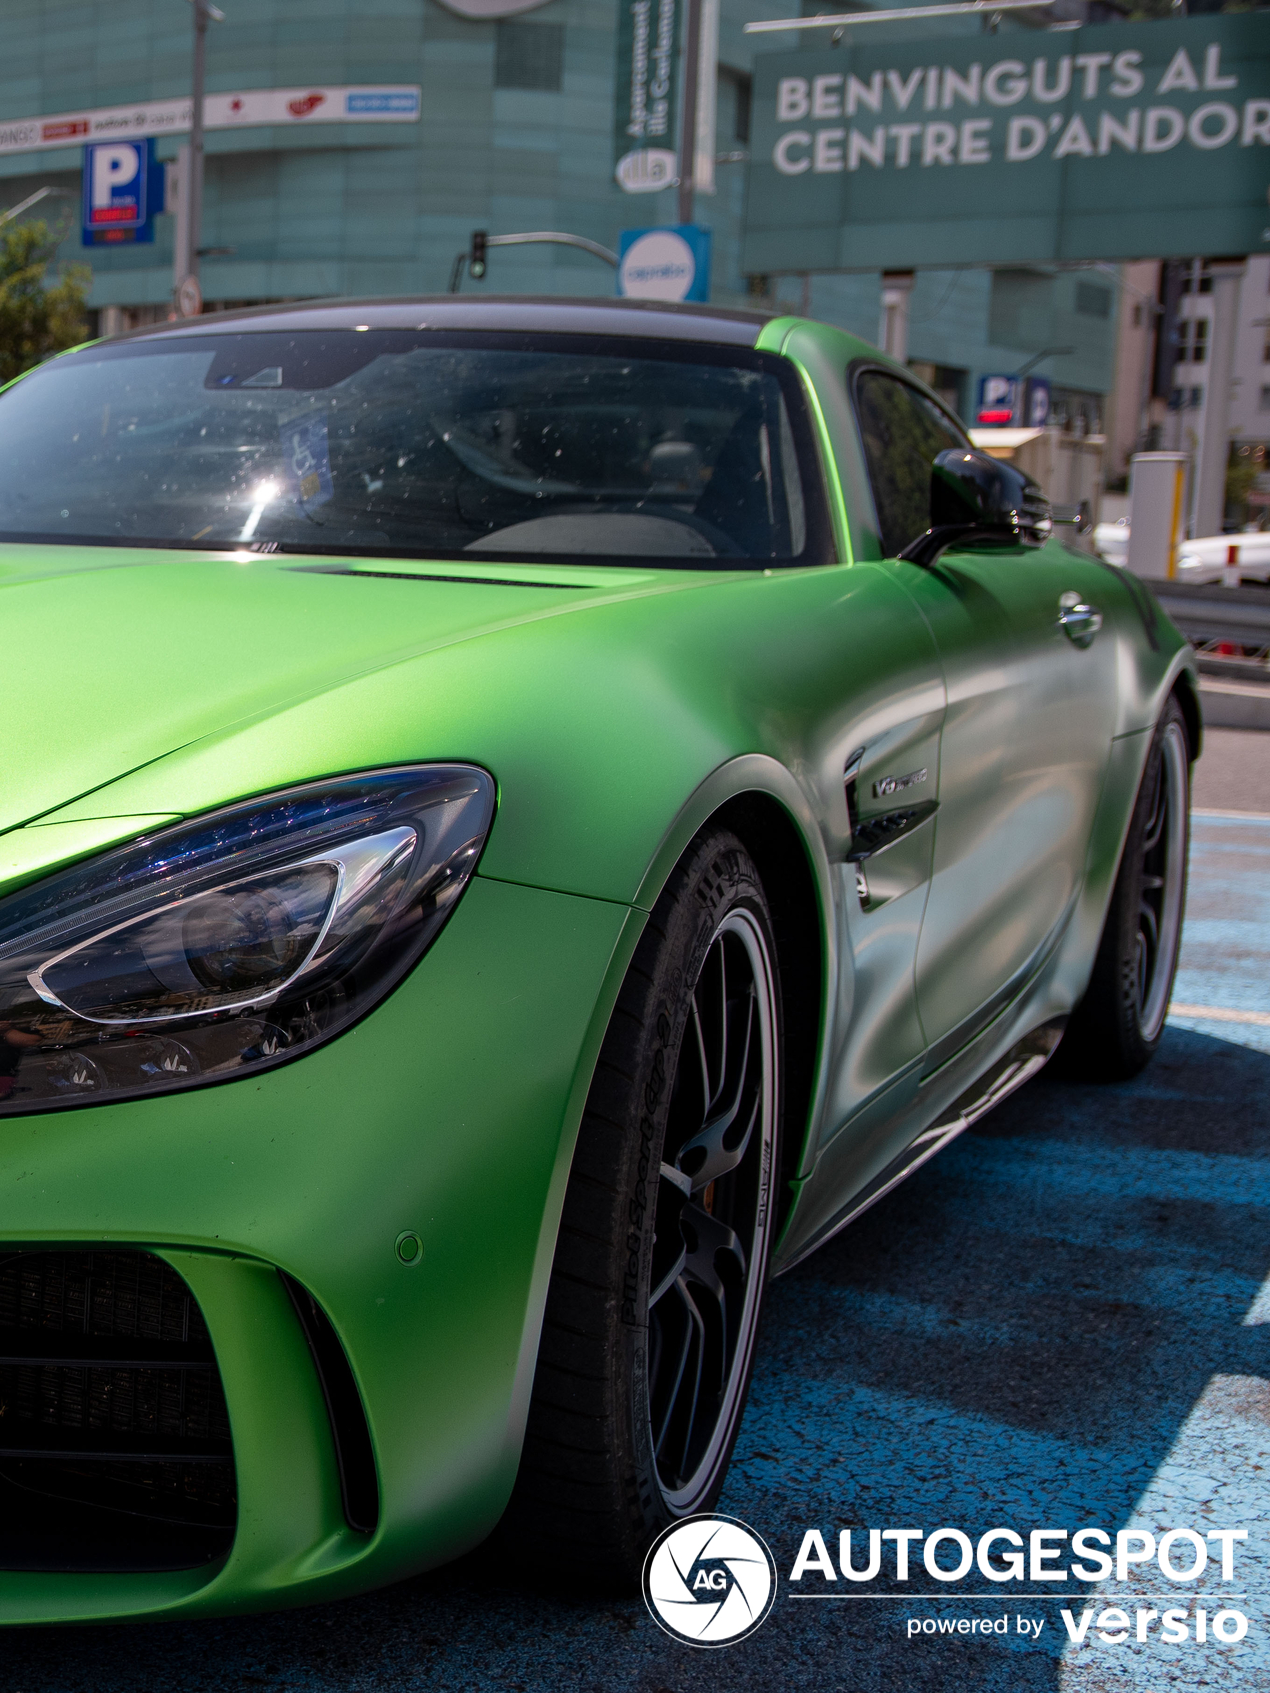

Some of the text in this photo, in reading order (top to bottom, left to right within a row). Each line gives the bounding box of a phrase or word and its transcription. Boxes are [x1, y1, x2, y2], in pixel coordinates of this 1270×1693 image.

[776, 42, 1238, 122] BENVINGUTS AL
[92, 143, 139, 208] P
[772, 117, 993, 175] CENTRE
[657, 1013, 671, 1049] 2
[645, 1049, 664, 1114] Cup
[629, 1117, 654, 1231] Sport
[621, 1232, 640, 1326] Pilot
